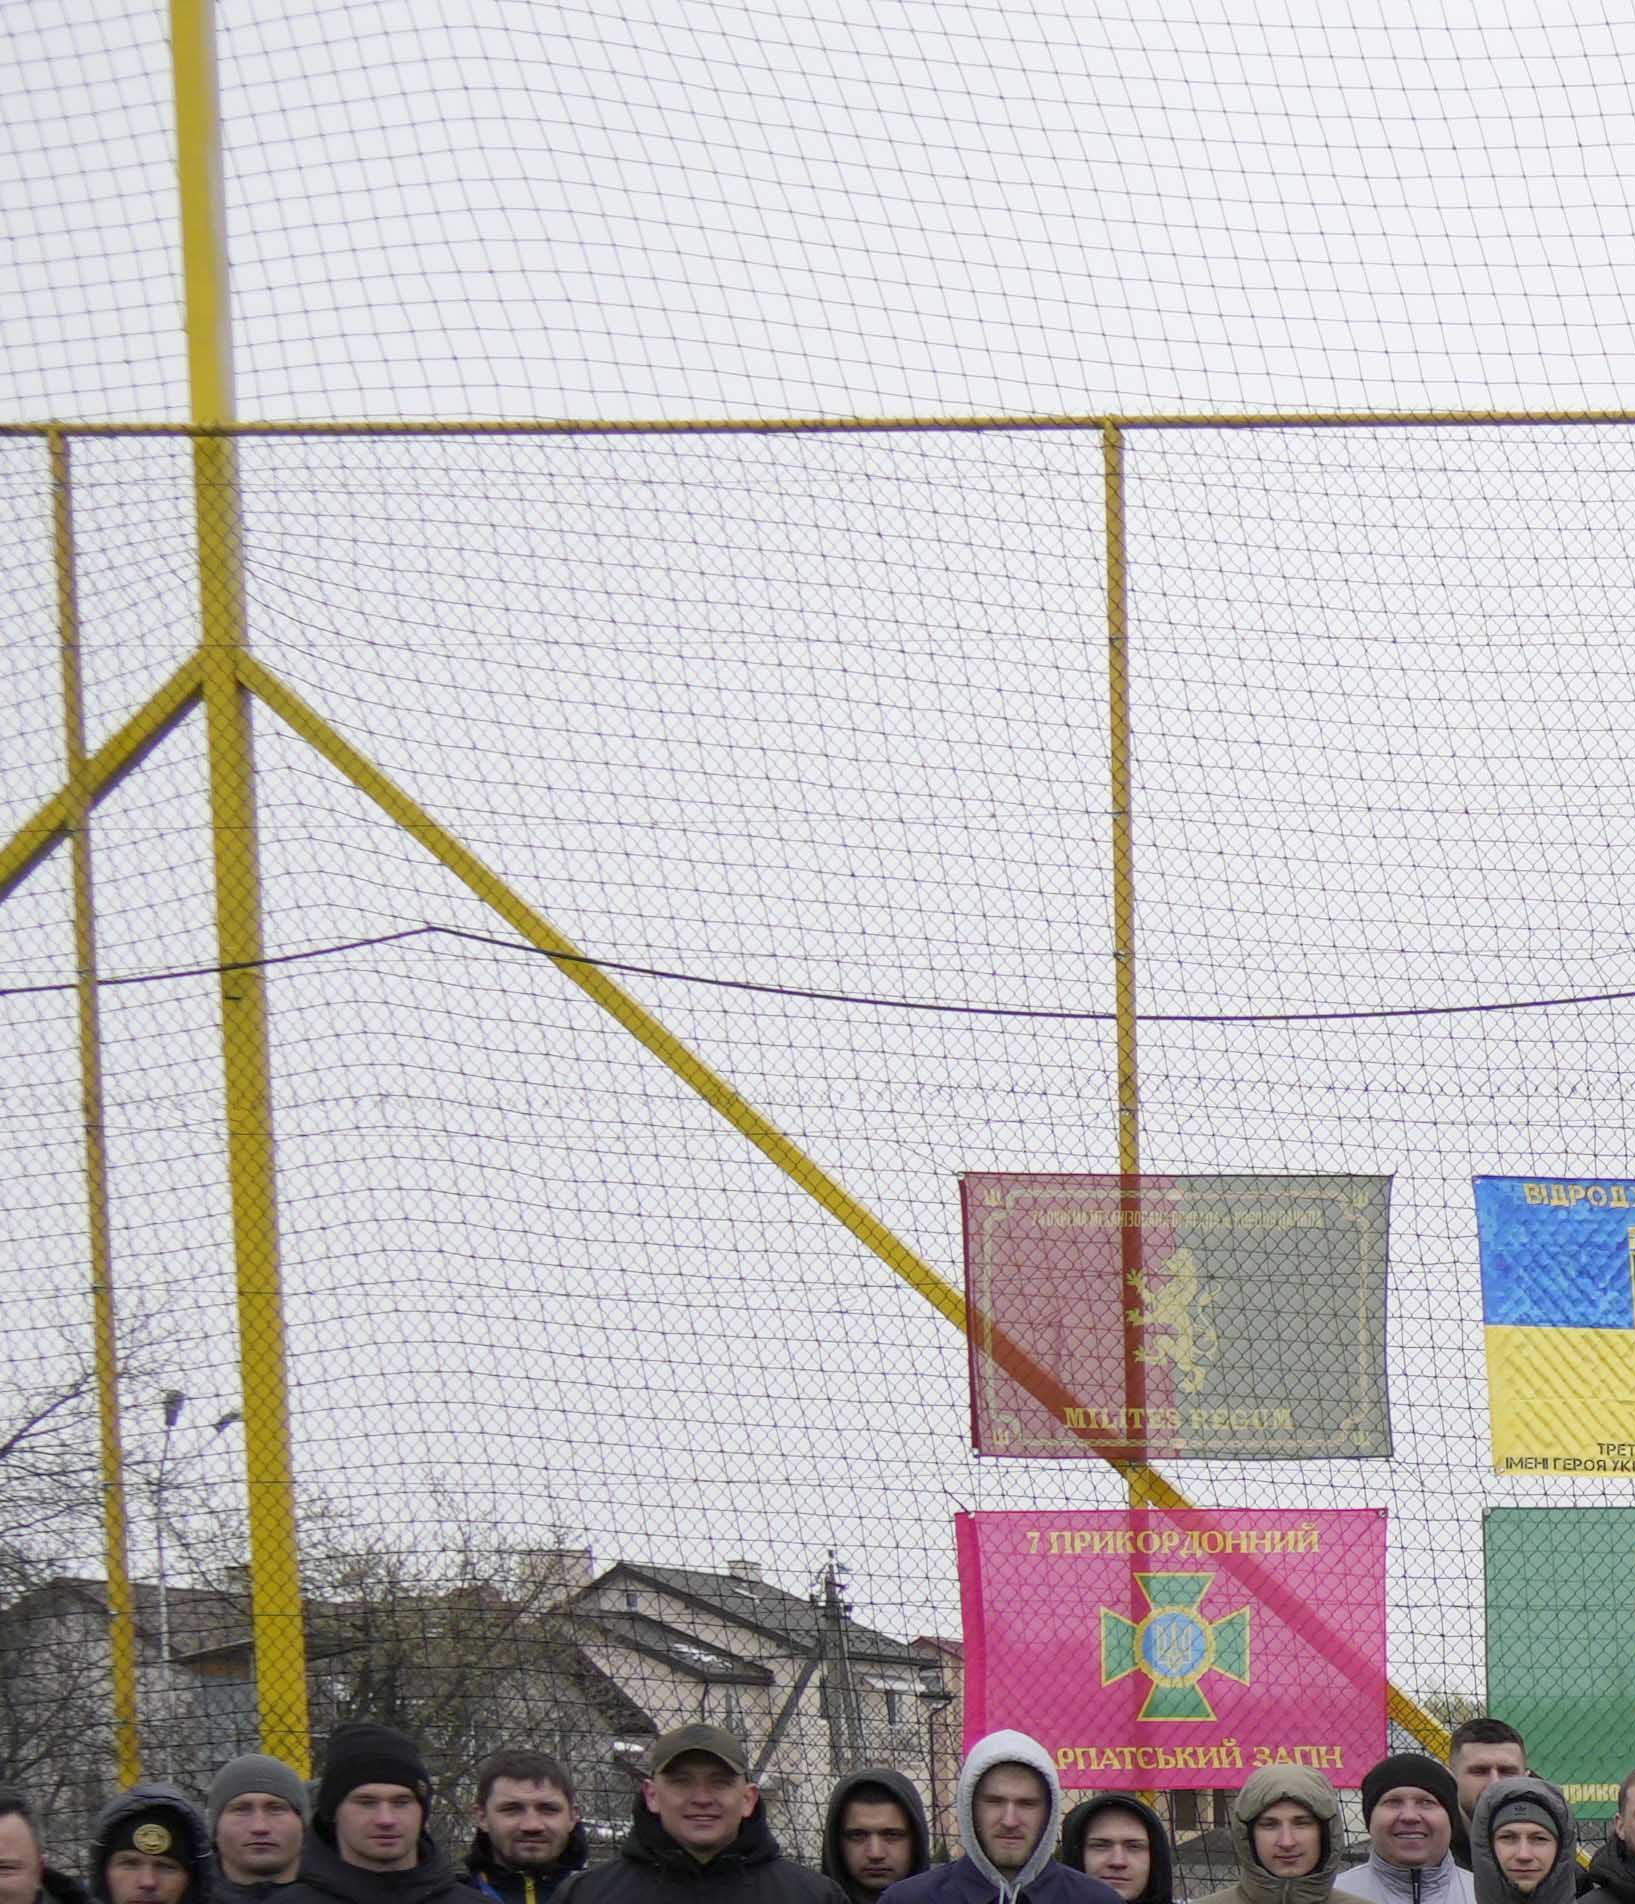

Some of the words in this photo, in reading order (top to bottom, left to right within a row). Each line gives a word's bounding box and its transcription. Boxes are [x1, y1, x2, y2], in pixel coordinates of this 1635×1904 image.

[1063, 1408, 1182, 1429] MILITES
[1505, 1457, 1549, 1470] ІМЕНІ
[1553, 1458, 1607, 1472] ГЕРОЯ
[1026, 1531, 1040, 1553] 7
[1050, 1522, 1320, 1558] ПРИКОРДОННИЙ
[1055, 1737, 1244, 1770] РПАТСЬКИЙ
[1252, 1745, 1345, 1768] ЗАГІН
